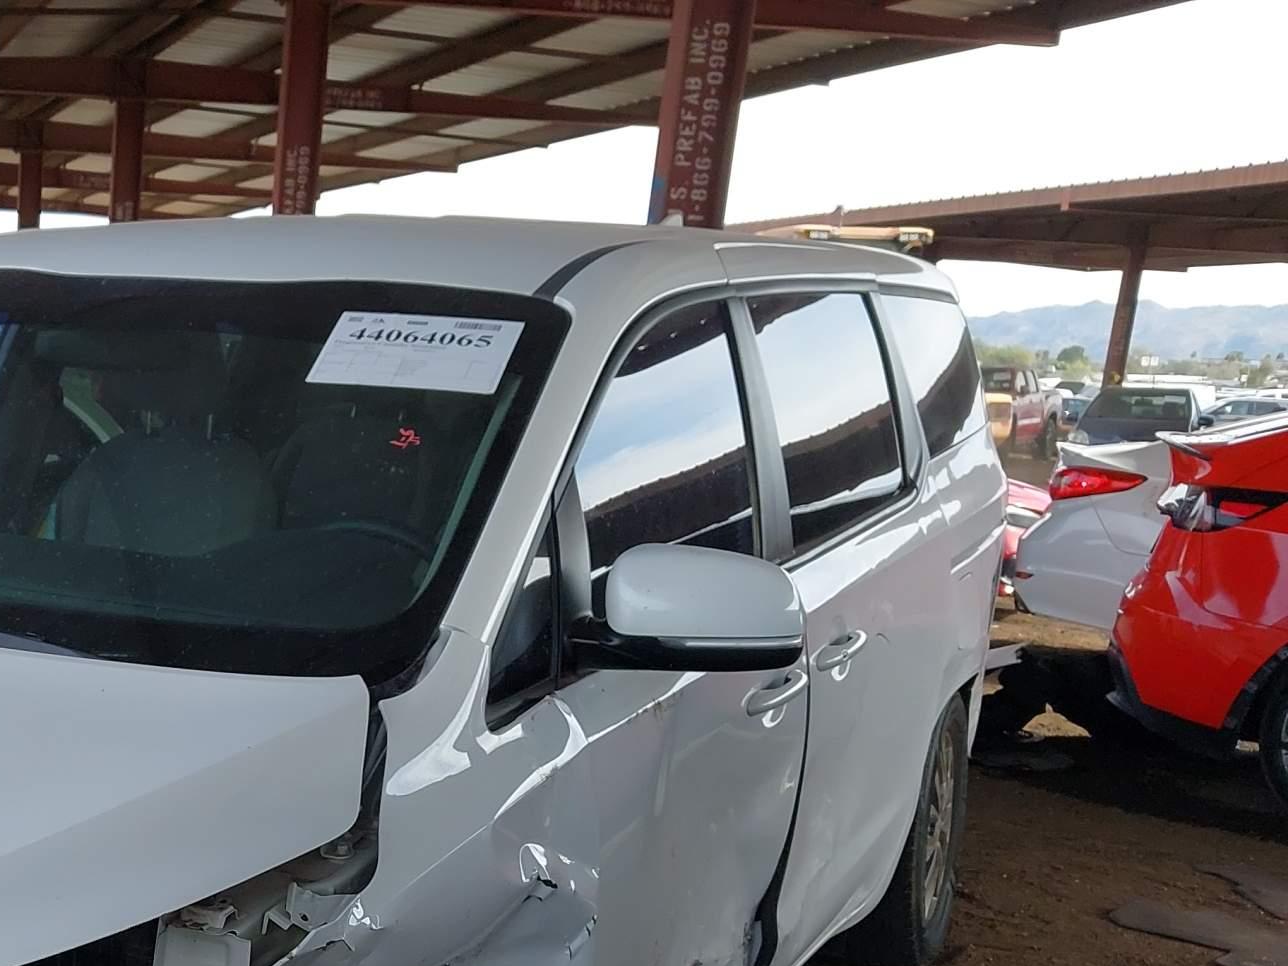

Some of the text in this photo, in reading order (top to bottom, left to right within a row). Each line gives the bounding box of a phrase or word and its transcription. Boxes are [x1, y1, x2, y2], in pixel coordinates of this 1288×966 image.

[675, 77, 702, 166] PREFAB
[690, 19, 711, 64] INC.
[687, 22, 731, 221] 1-866-799-0969
[349, 327, 494, 349] 44064065
